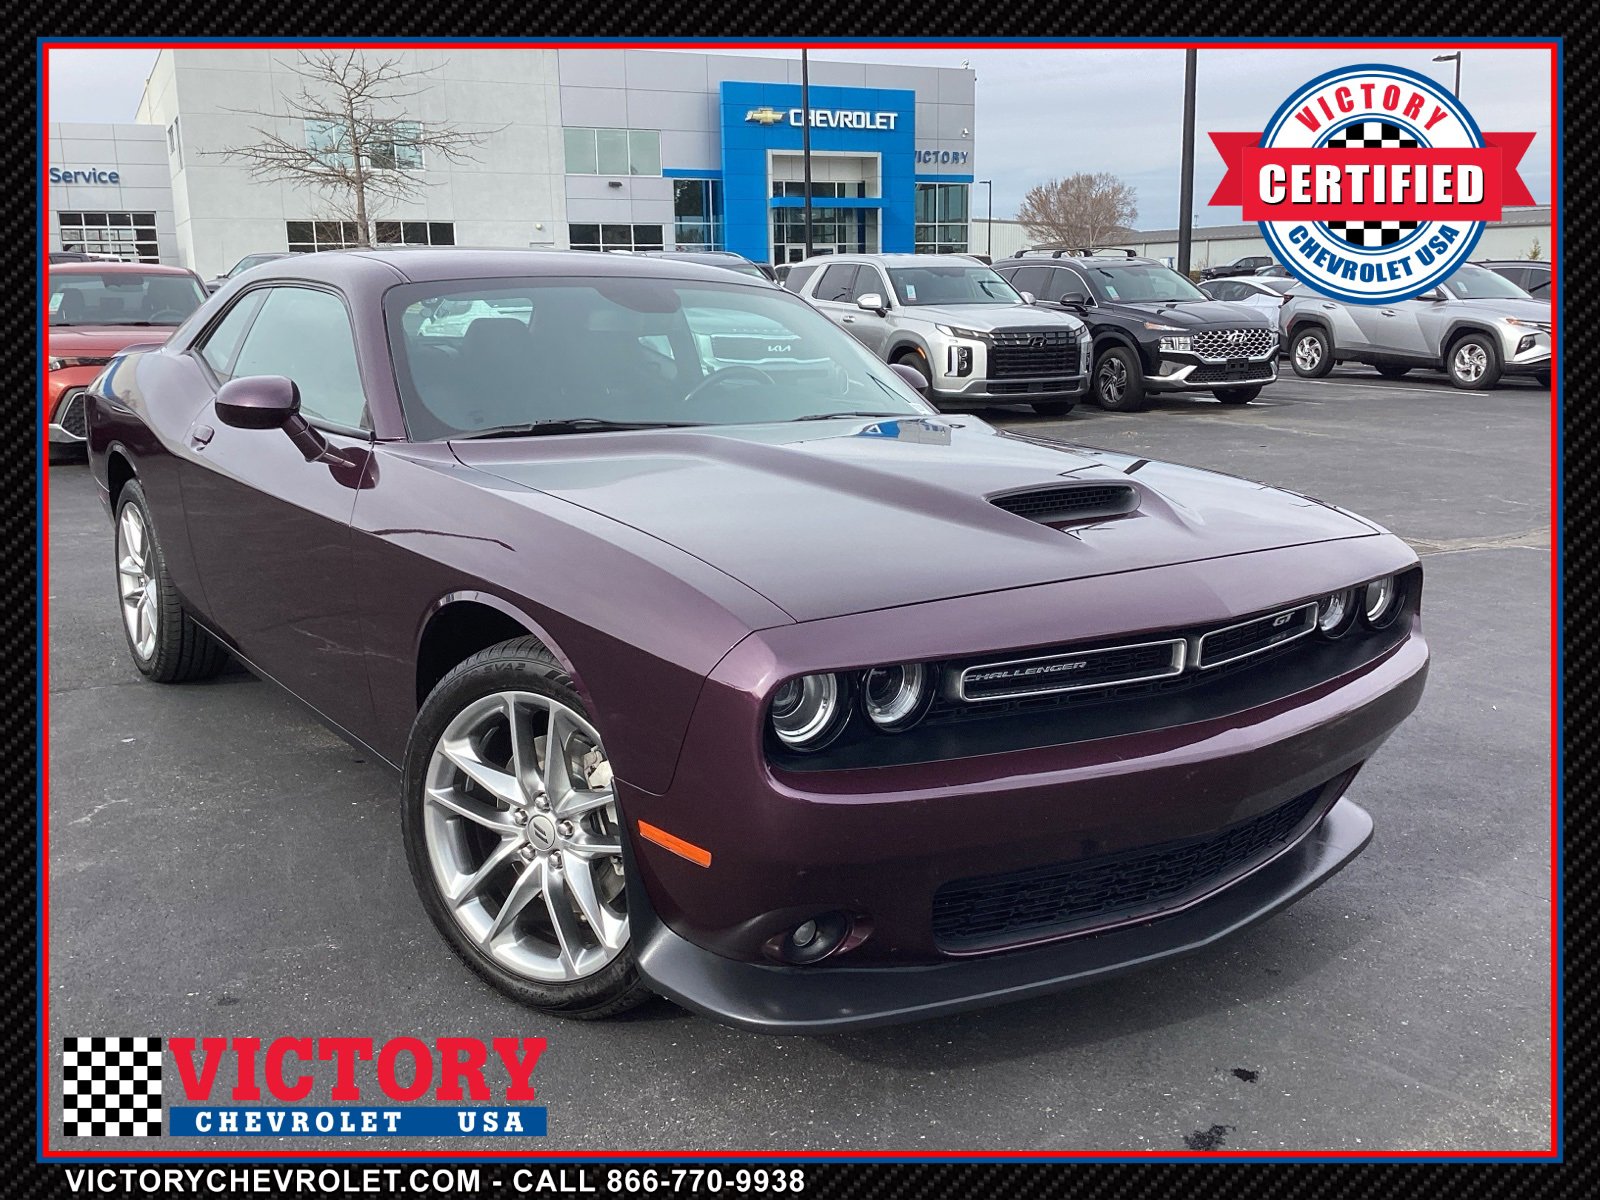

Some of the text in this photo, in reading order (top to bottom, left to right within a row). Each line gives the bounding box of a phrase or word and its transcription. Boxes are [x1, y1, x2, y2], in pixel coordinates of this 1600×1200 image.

[789, 108, 898, 130] CHEVROLET
[49, 167, 120, 184] Service
[1272, 611, 1296, 627] GT
[963, 661, 1087, 682] CHALLENGER
